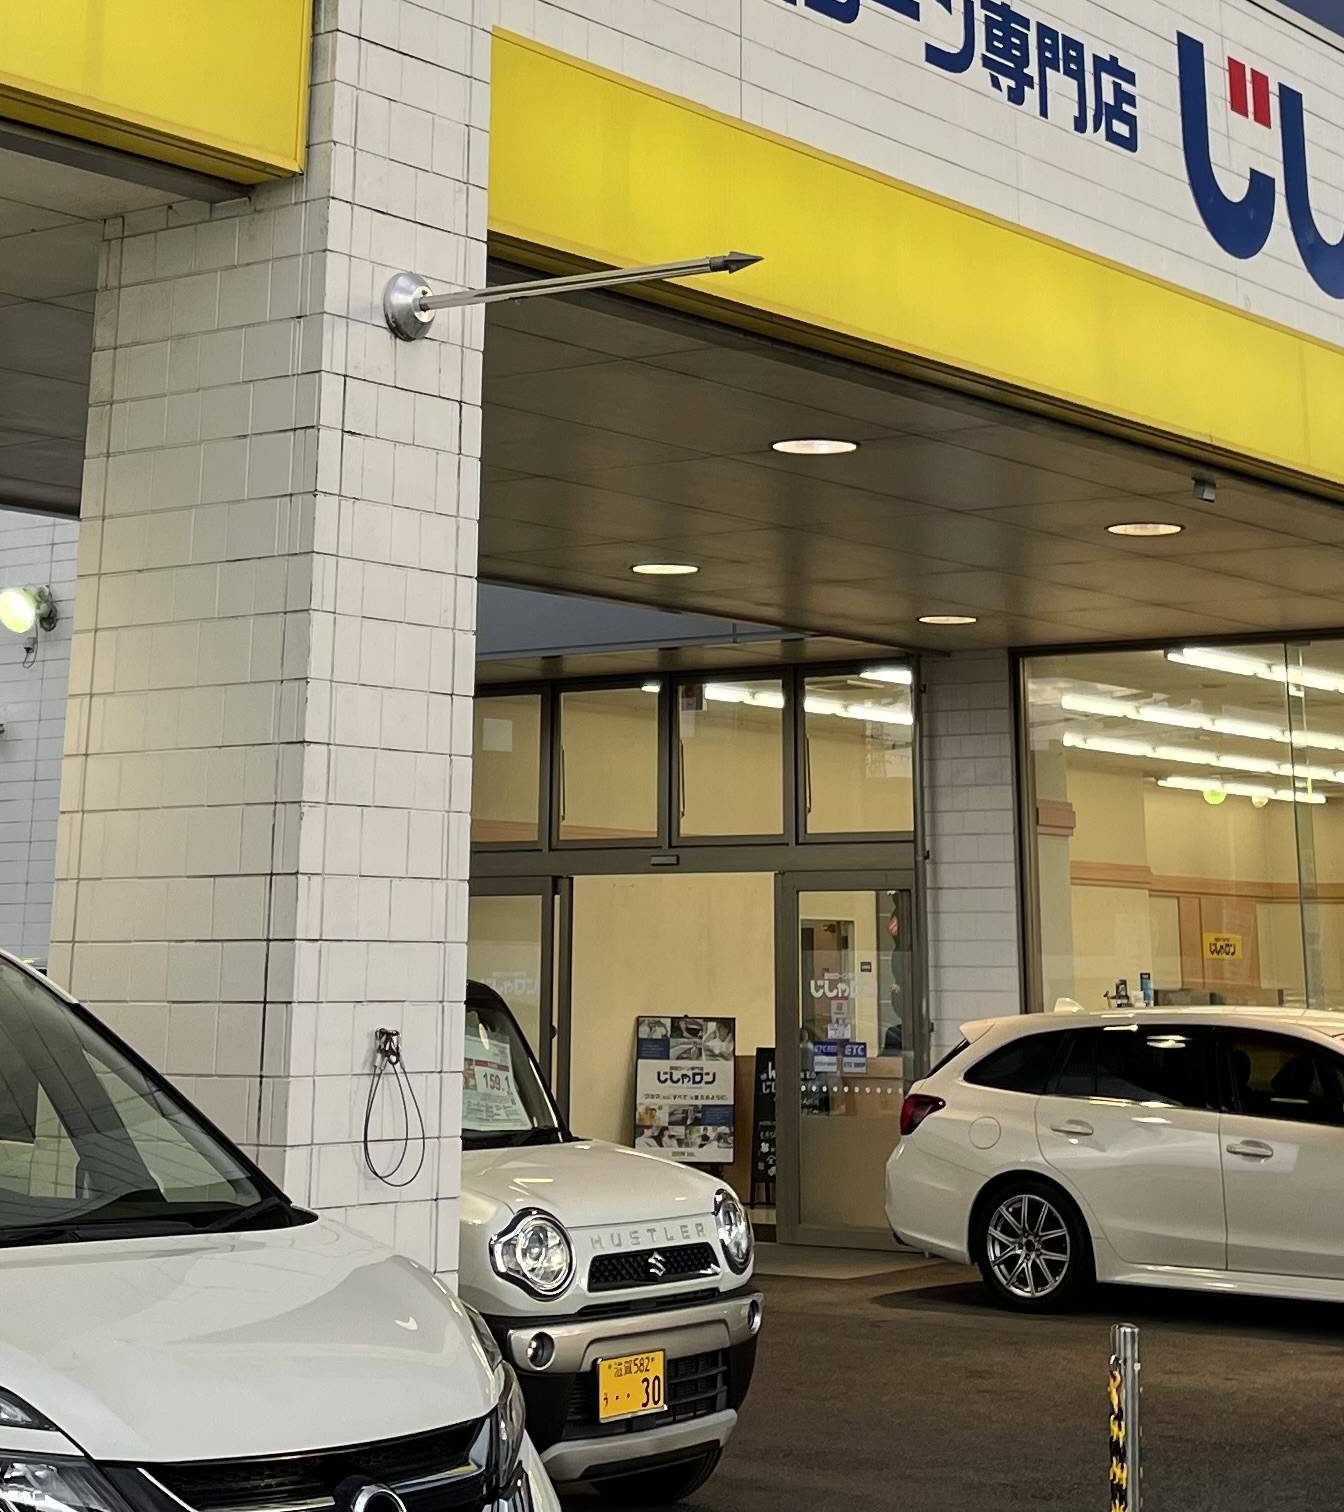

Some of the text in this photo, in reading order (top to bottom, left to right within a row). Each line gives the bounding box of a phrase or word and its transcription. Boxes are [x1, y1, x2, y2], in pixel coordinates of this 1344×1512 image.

[844, 1044, 865, 1056] ETC
[657, 1070, 716, 1085] じしゃロン
[591, 1222, 705, 1250] HUSTLER
